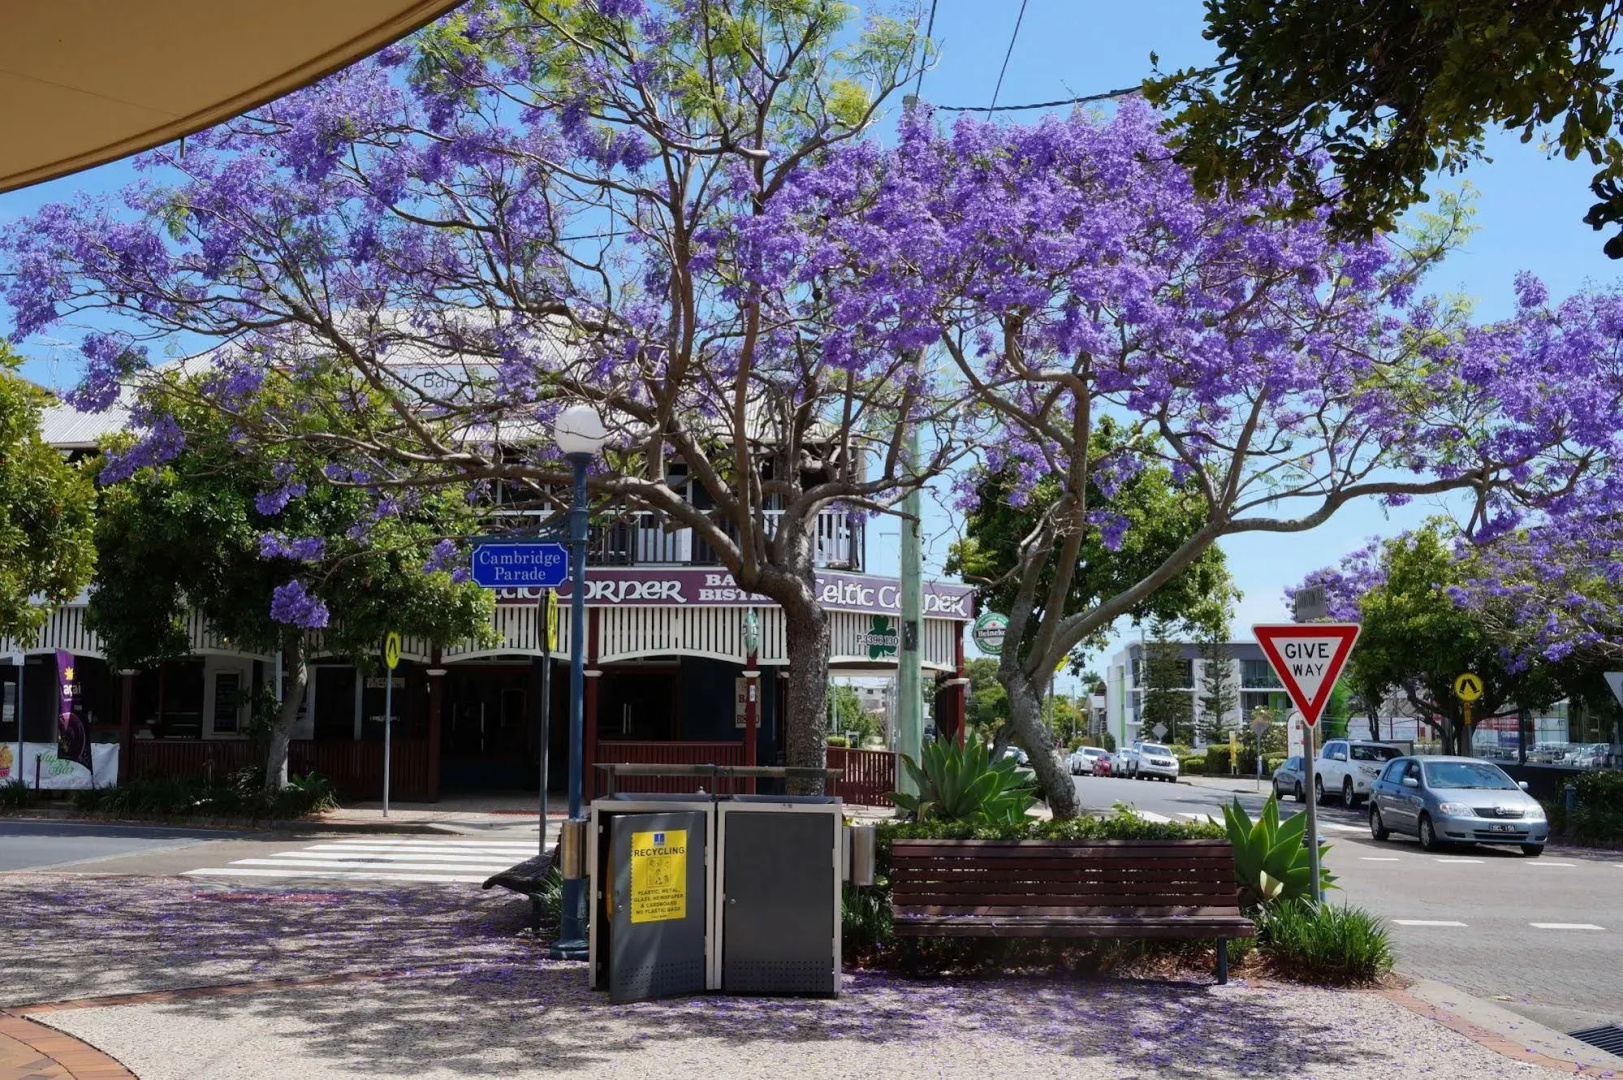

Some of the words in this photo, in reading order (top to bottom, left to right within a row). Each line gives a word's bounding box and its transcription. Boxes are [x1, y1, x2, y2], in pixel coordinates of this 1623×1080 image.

[479, 550, 561, 566] Cambridge
[494, 567, 546, 581] Parade
[705, 574, 738, 586] BA
[815, 578, 875, 606] Celtic
[878, 585, 968, 617] Coner
[1285, 642, 1330, 660] GIVE
[1292, 663, 1324, 677] WAY
[634, 846, 685, 857] RECYCLING
